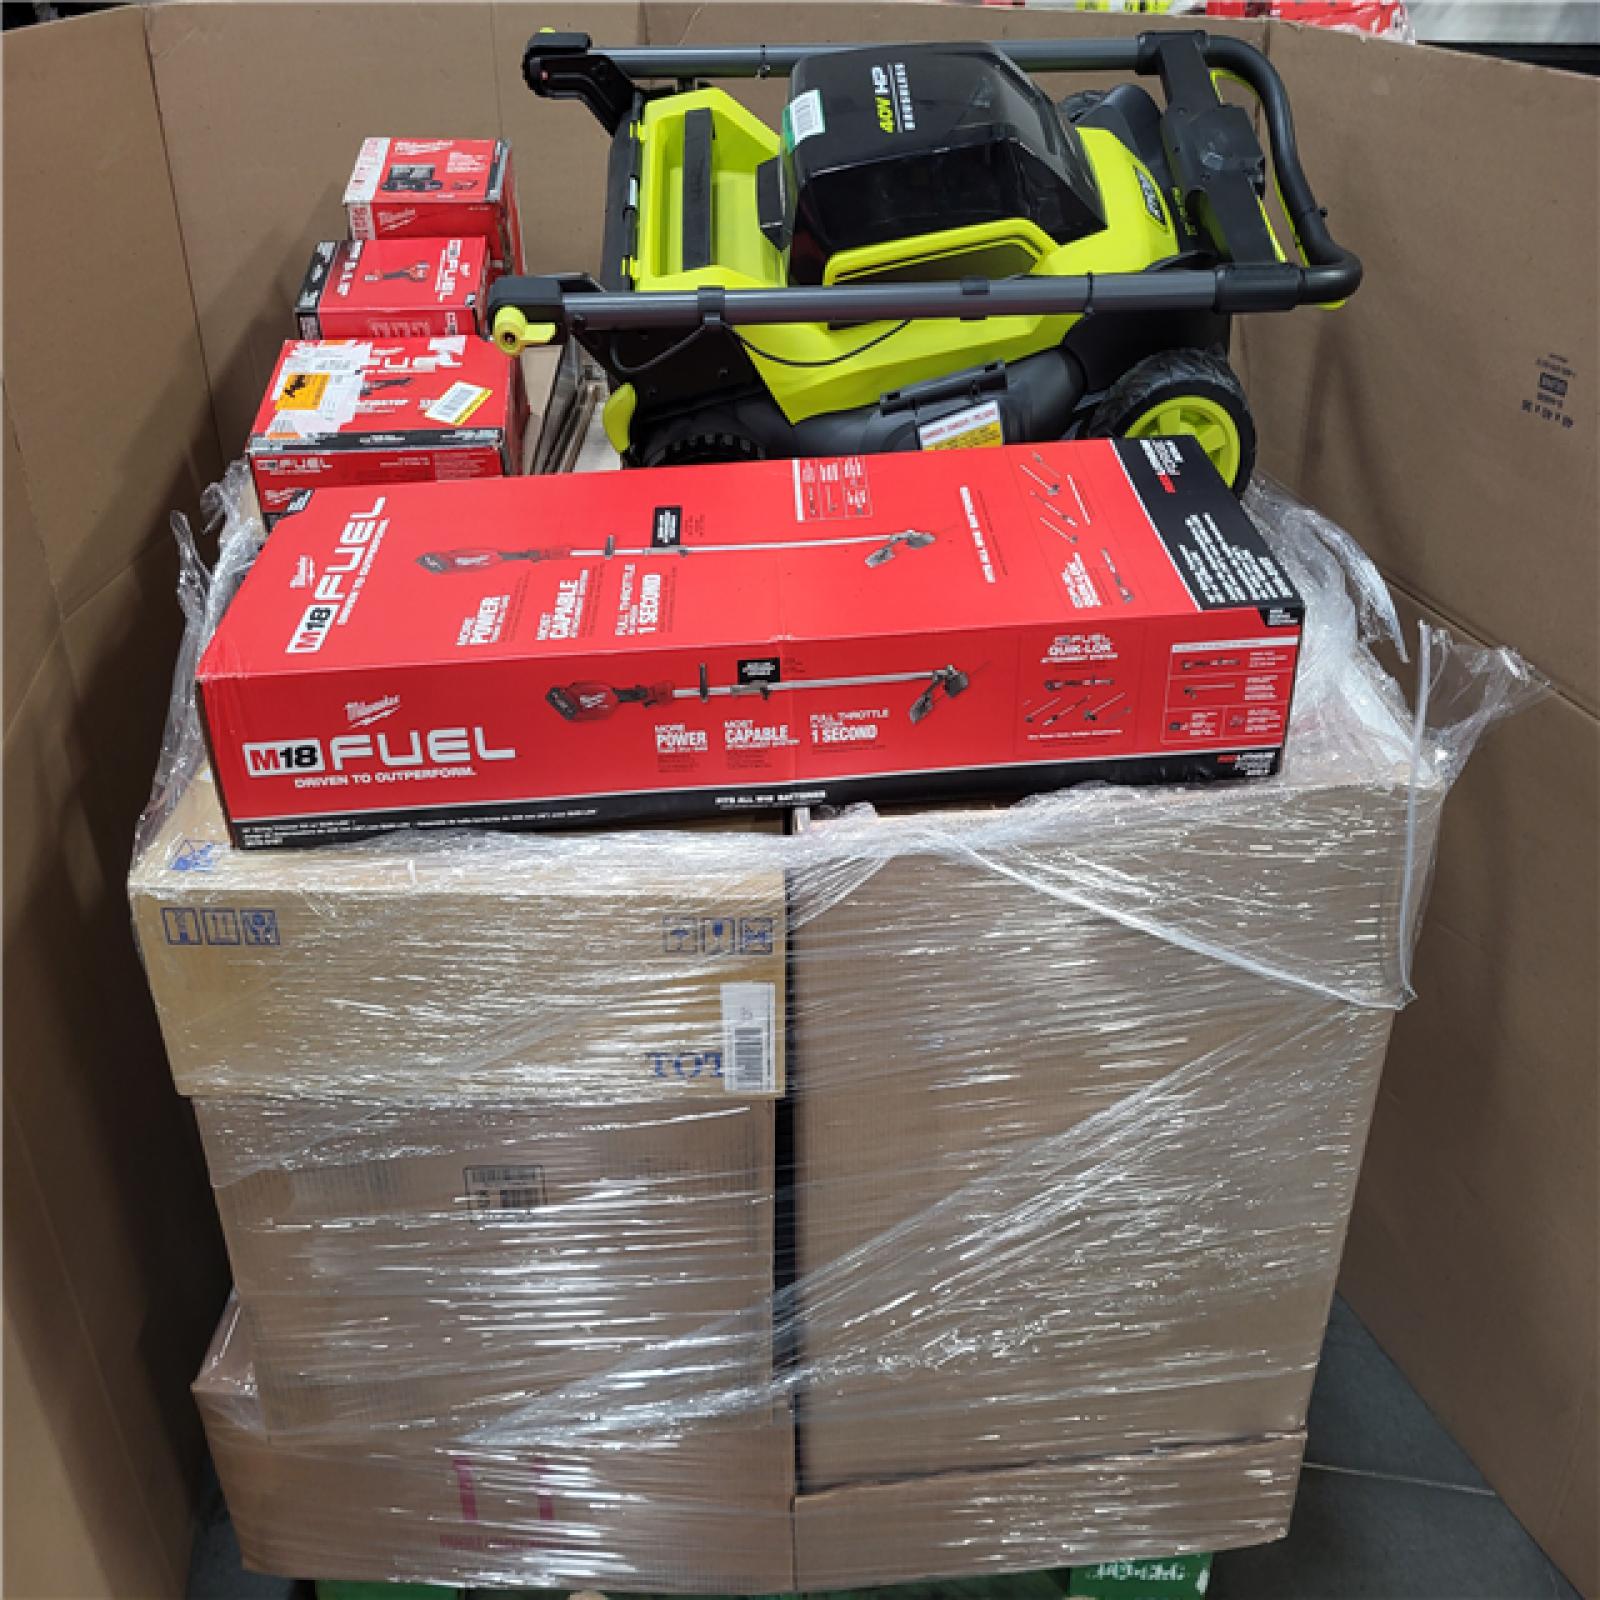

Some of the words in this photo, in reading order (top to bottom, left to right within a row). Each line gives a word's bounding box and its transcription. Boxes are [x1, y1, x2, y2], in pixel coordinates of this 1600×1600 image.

[871, 66, 890, 95] HP
[294, 605, 332, 651] M18
[314, 496, 387, 601] FUEL
[469, 595, 501, 644] POWER
[838, 708, 890, 720] THROTTLE
[657, 731, 707, 747] POWER
[725, 725, 789, 742] CAPABLE
[811, 730, 819, 744] 1
[822, 724, 877, 743] SECOND
[249, 745, 319, 772] M18
[329, 726, 516, 770] FUEL
[295, 776, 349, 789] DRIVEN
[352, 772, 371, 785] TO
